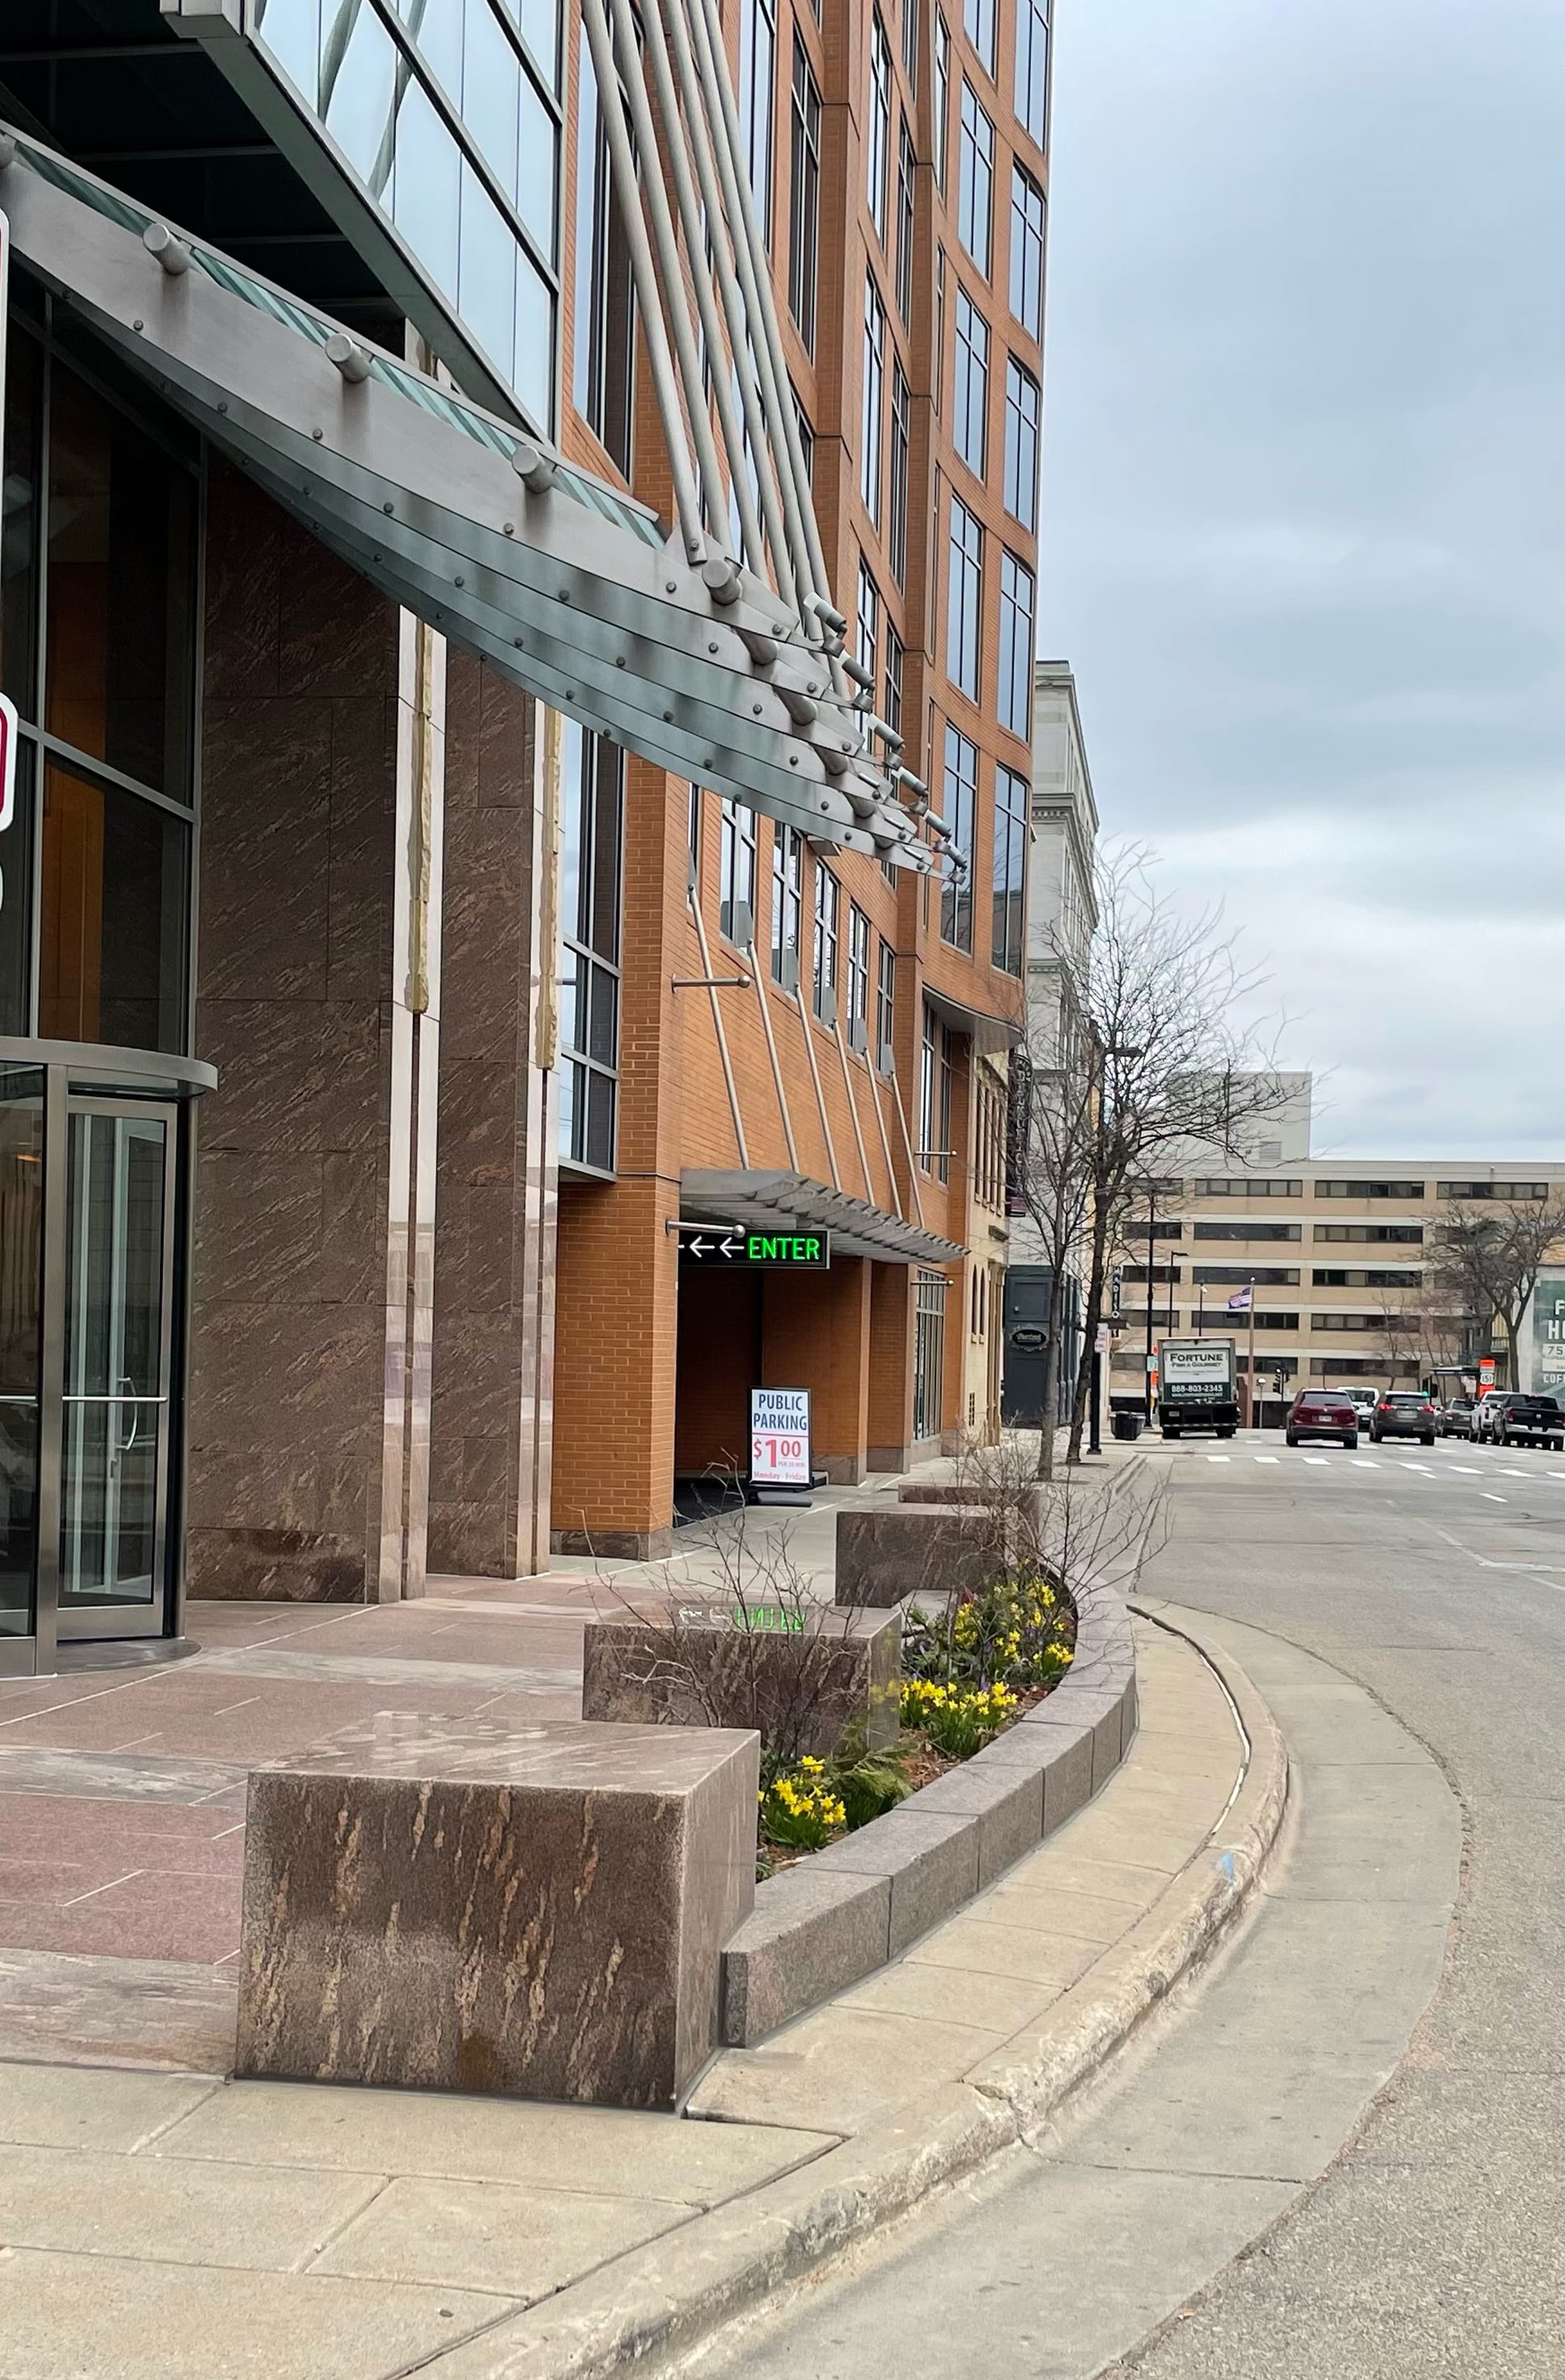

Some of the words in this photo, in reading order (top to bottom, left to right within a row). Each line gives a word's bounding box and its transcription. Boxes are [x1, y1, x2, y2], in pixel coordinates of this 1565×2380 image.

[749, 1237, 820, 1260] ENTER
[1170, 1353, 1224, 1362] FORTUNE
[1543, 1373, 1565, 1384] COF
[759, 1394, 803, 1411] PUBLIC
[753, 1412, 807, 1431] PARKING
[753, 1470, 780, 1479] Monday
[786, 1472, 807, 1481] Friday
